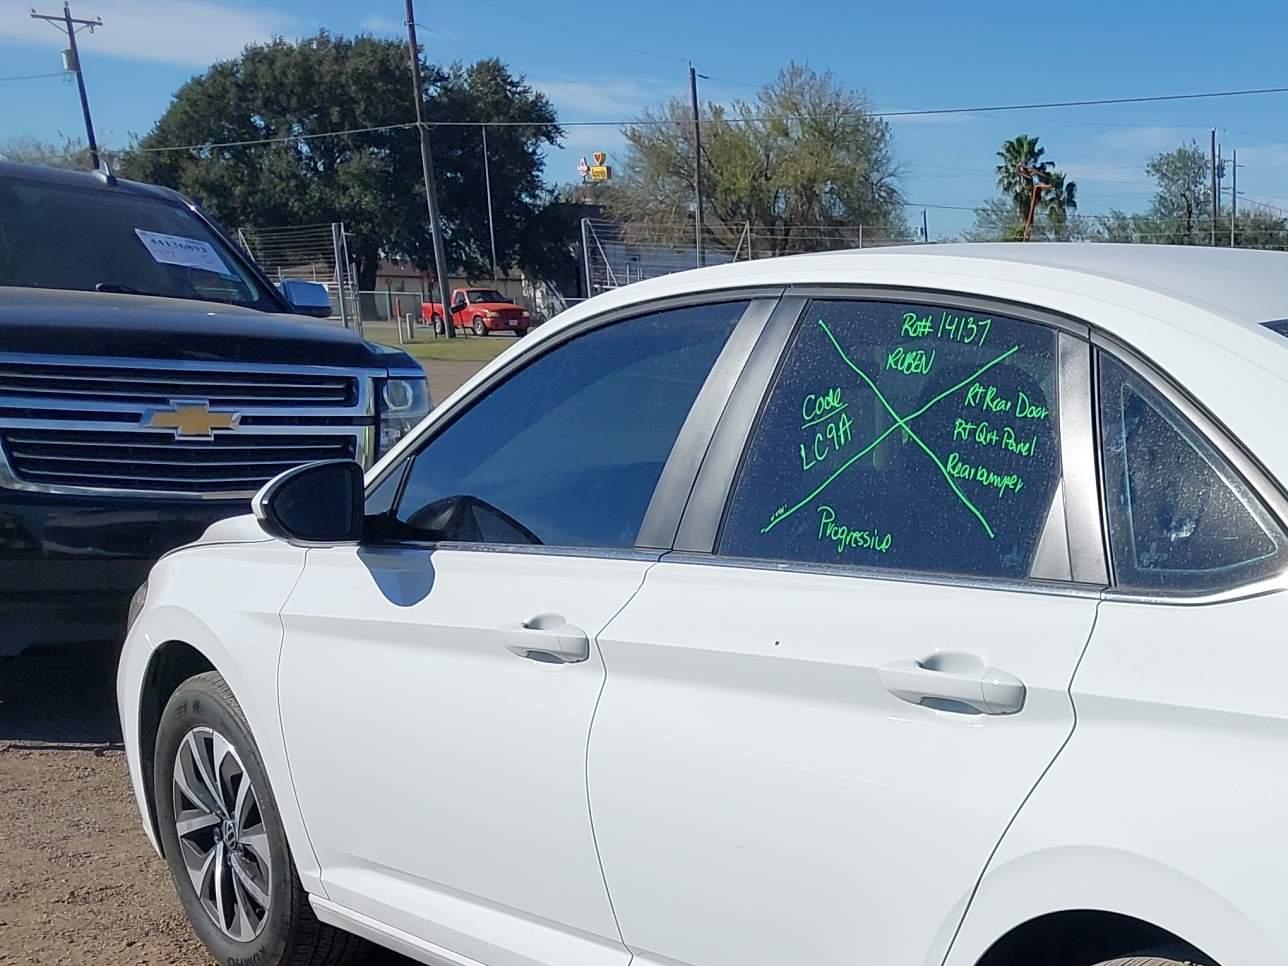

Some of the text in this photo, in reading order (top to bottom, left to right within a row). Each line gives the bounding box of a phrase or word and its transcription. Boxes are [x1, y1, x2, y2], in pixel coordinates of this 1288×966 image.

[937, 311, 992, 347] 14137
[886, 347, 936, 375] RUBEN
[802, 387, 844, 420] Code
[982, 385, 1012, 412] Rear
[1015, 391, 1049, 420] Door
[1001, 426, 1038, 457] Panel
